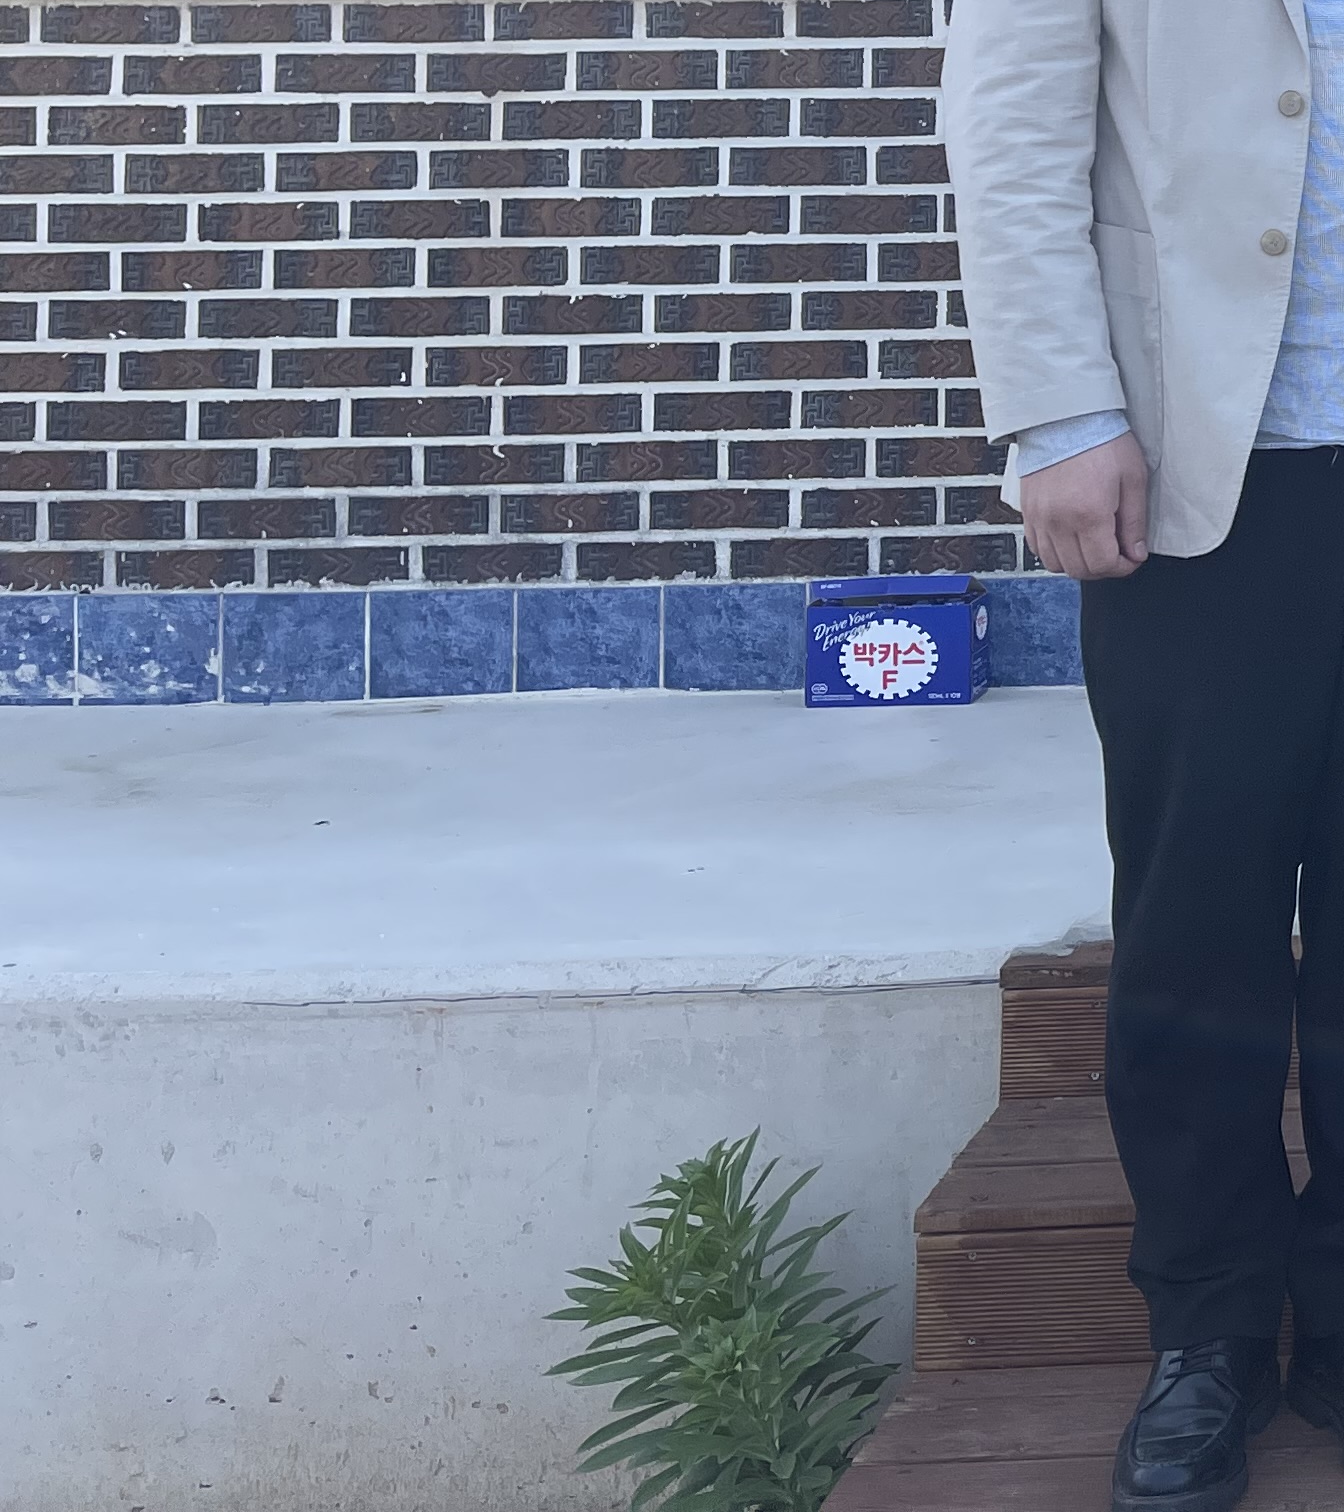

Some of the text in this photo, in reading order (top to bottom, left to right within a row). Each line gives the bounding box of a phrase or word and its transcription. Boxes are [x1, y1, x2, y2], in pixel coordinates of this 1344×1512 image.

[812, 611, 876, 642] Drive Your
[853, 642, 926, 667] 박카스
[882, 670, 899, 690] F
